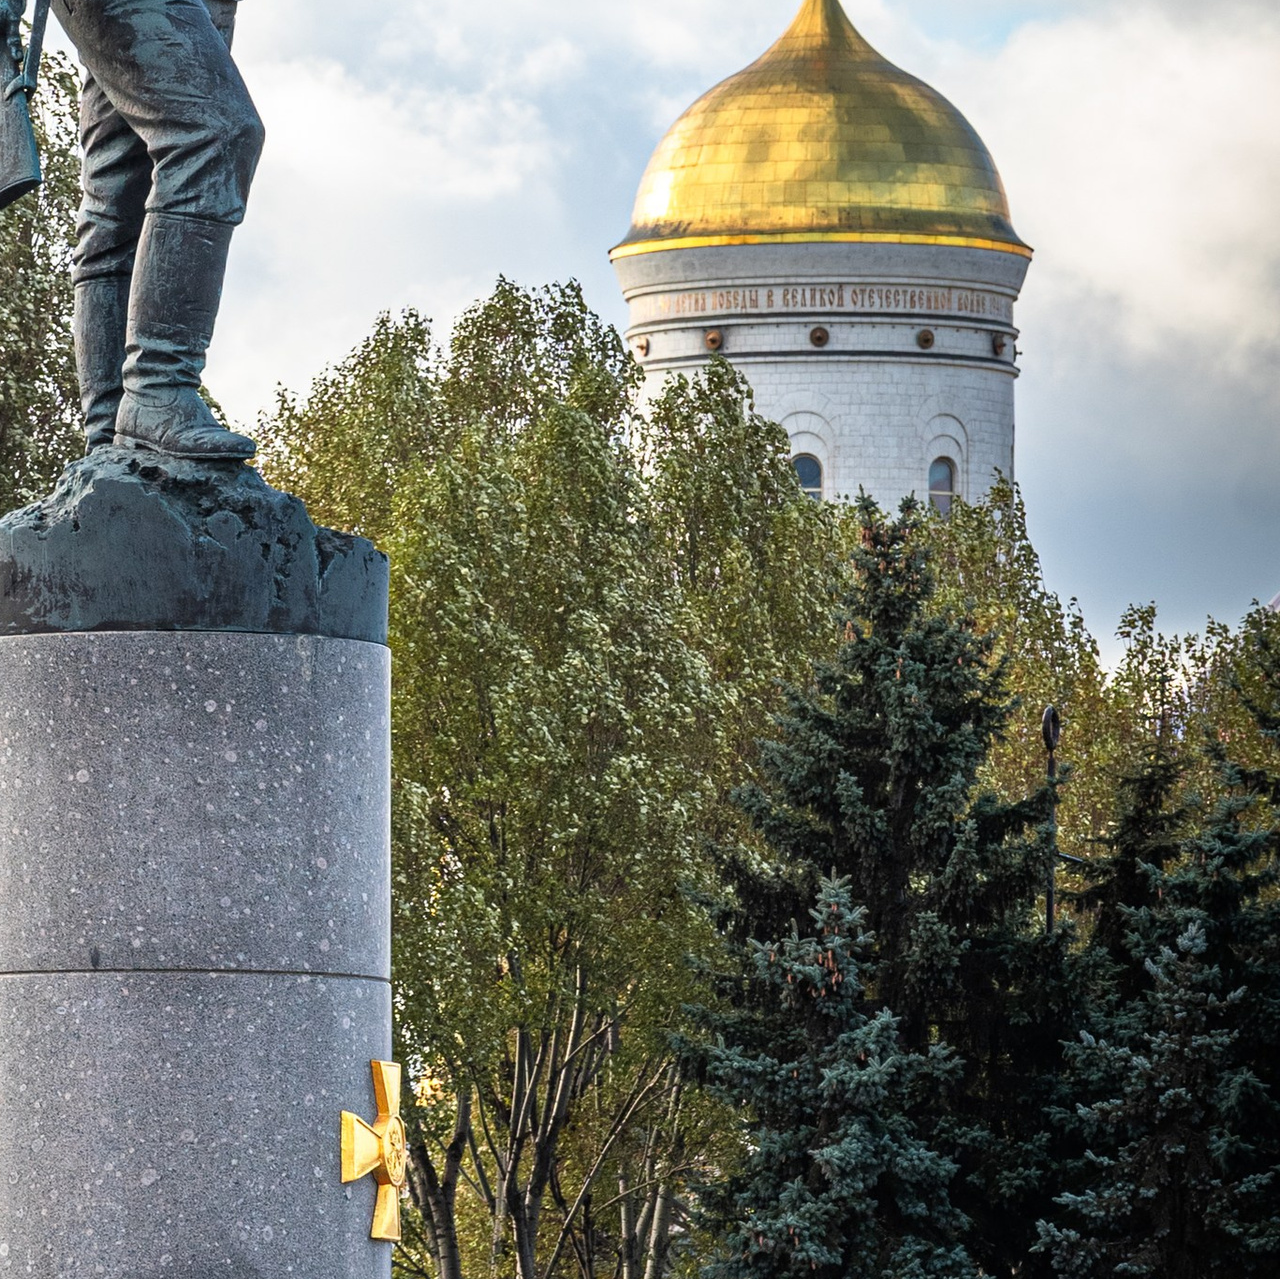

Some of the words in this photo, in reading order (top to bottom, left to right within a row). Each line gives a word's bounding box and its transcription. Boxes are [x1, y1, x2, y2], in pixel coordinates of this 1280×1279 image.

[711, 289, 759, 310] ПОБЕДЫ
[767, 289, 774, 308] В
[783, 284, 844, 308] ВЕЛИКОЙ
[851, 286, 953, 310] ОТЕЧЕСТВЕННОЙ
